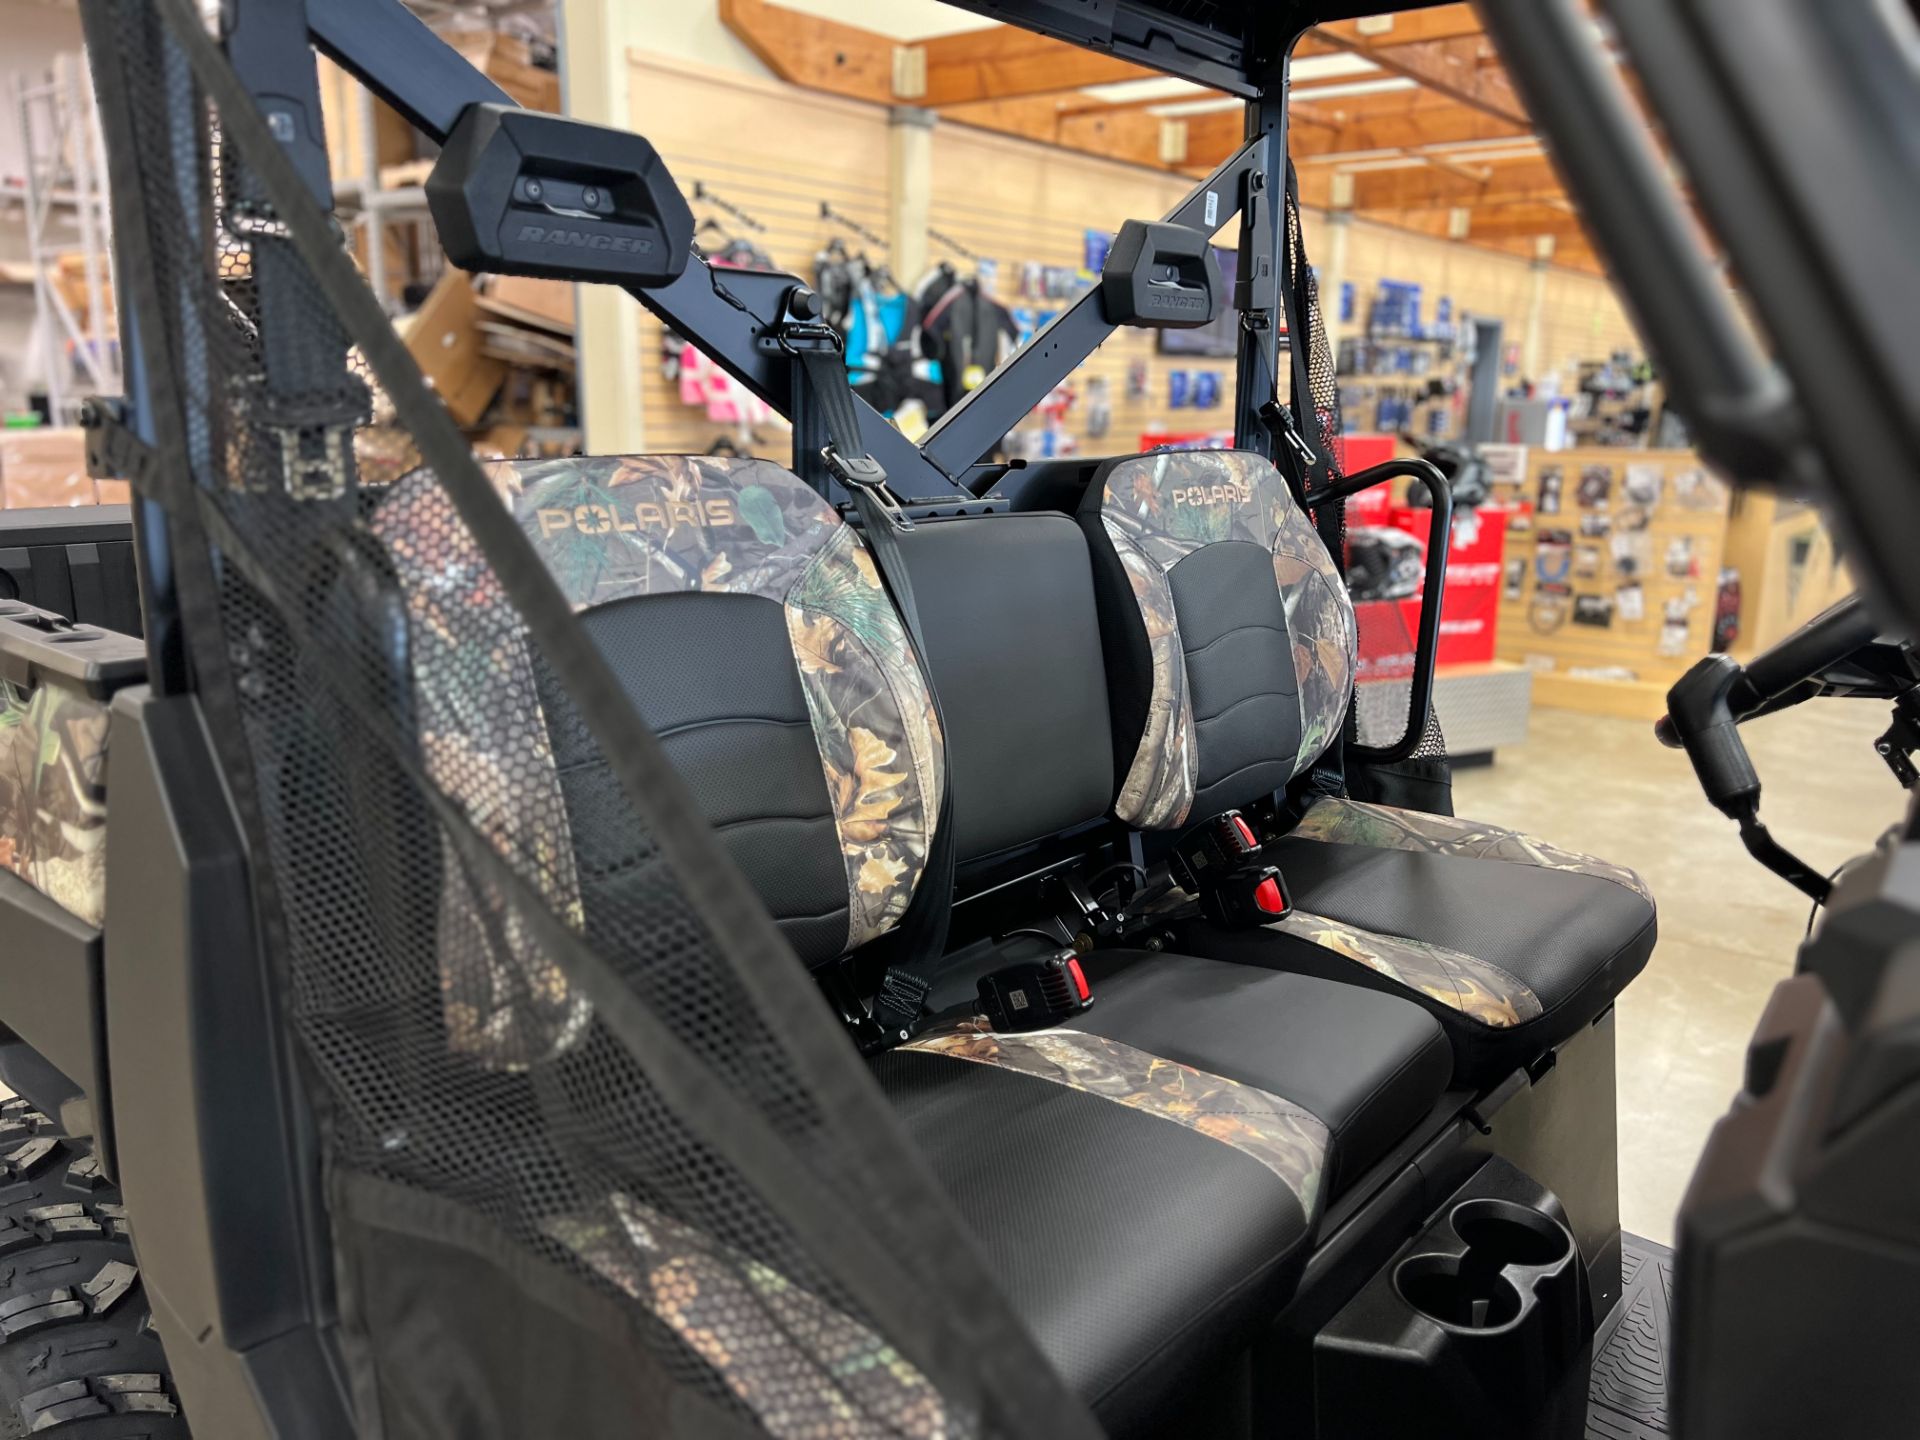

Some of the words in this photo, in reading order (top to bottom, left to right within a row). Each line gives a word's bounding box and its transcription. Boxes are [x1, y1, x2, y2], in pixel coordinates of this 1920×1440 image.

[517, 226, 653, 255] RANGER
[1151, 294, 1205, 310] RANGER
[1172, 484, 1251, 509] POLARIS
[536, 499, 735, 539] POLARIS
